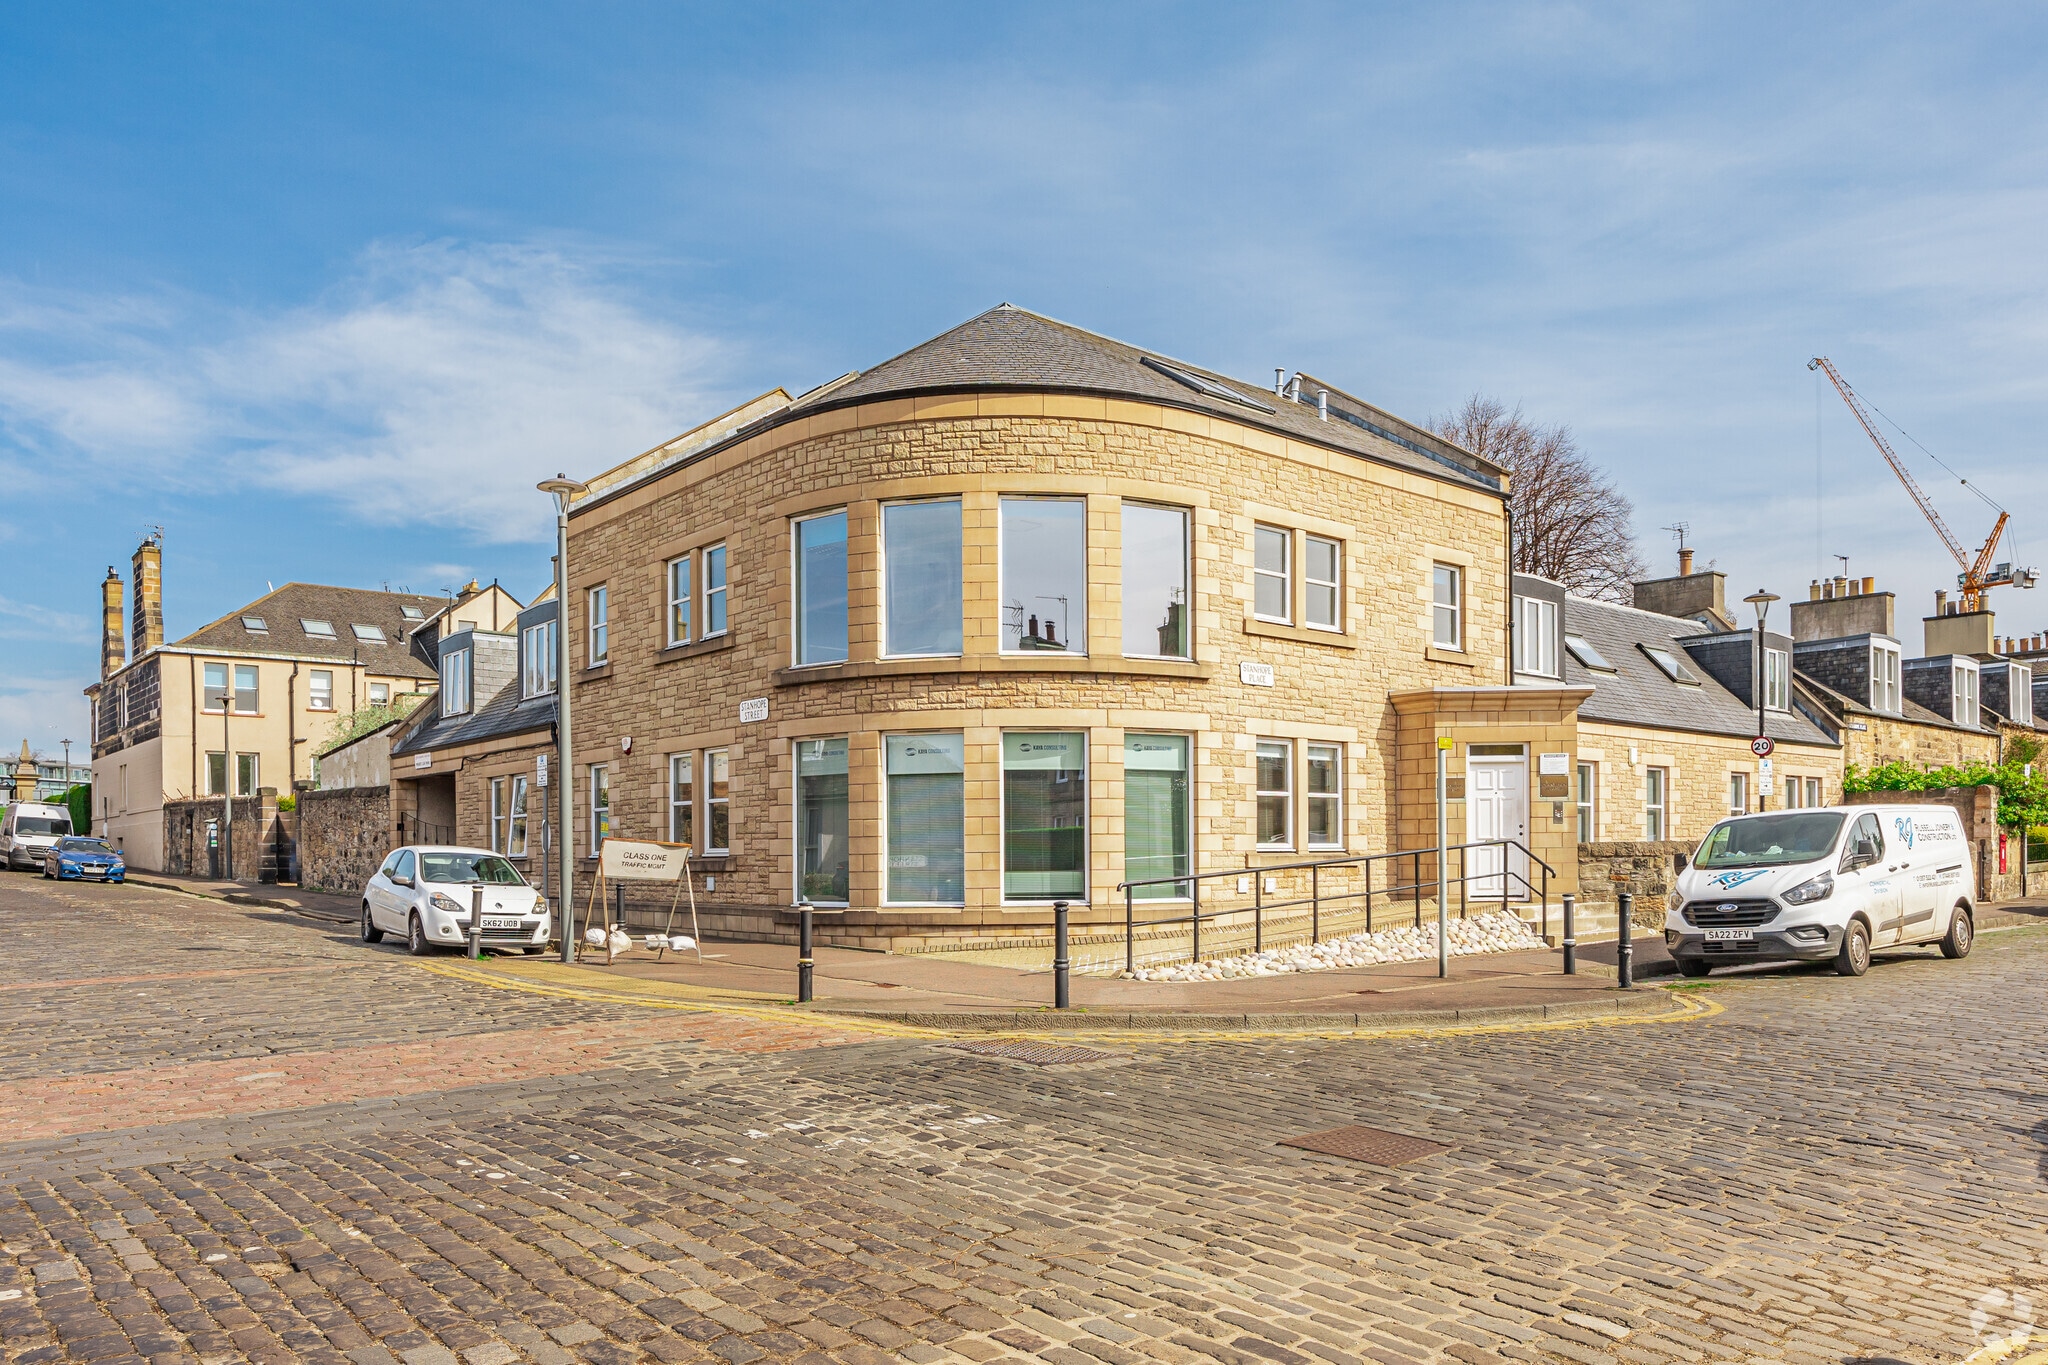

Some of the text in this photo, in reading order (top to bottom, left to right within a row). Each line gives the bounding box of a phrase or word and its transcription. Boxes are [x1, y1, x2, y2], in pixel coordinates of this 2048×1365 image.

[1243, 664, 1271, 674] STANHOPE
[1248, 674, 1266, 683] PLACE
[741, 699, 767, 711] STANHOPE
[744, 710, 763, 720] STREET
[1754, 741, 1769, 750] 20
[1917, 833, 1951, 841] CONSTRUCTION
[623, 851, 649, 861] CLASS
[621, 861, 647, 869] TRAFFIC
[482, 919, 502, 927] SK62
[1708, 930, 1750, 939] SA22 ZFV
